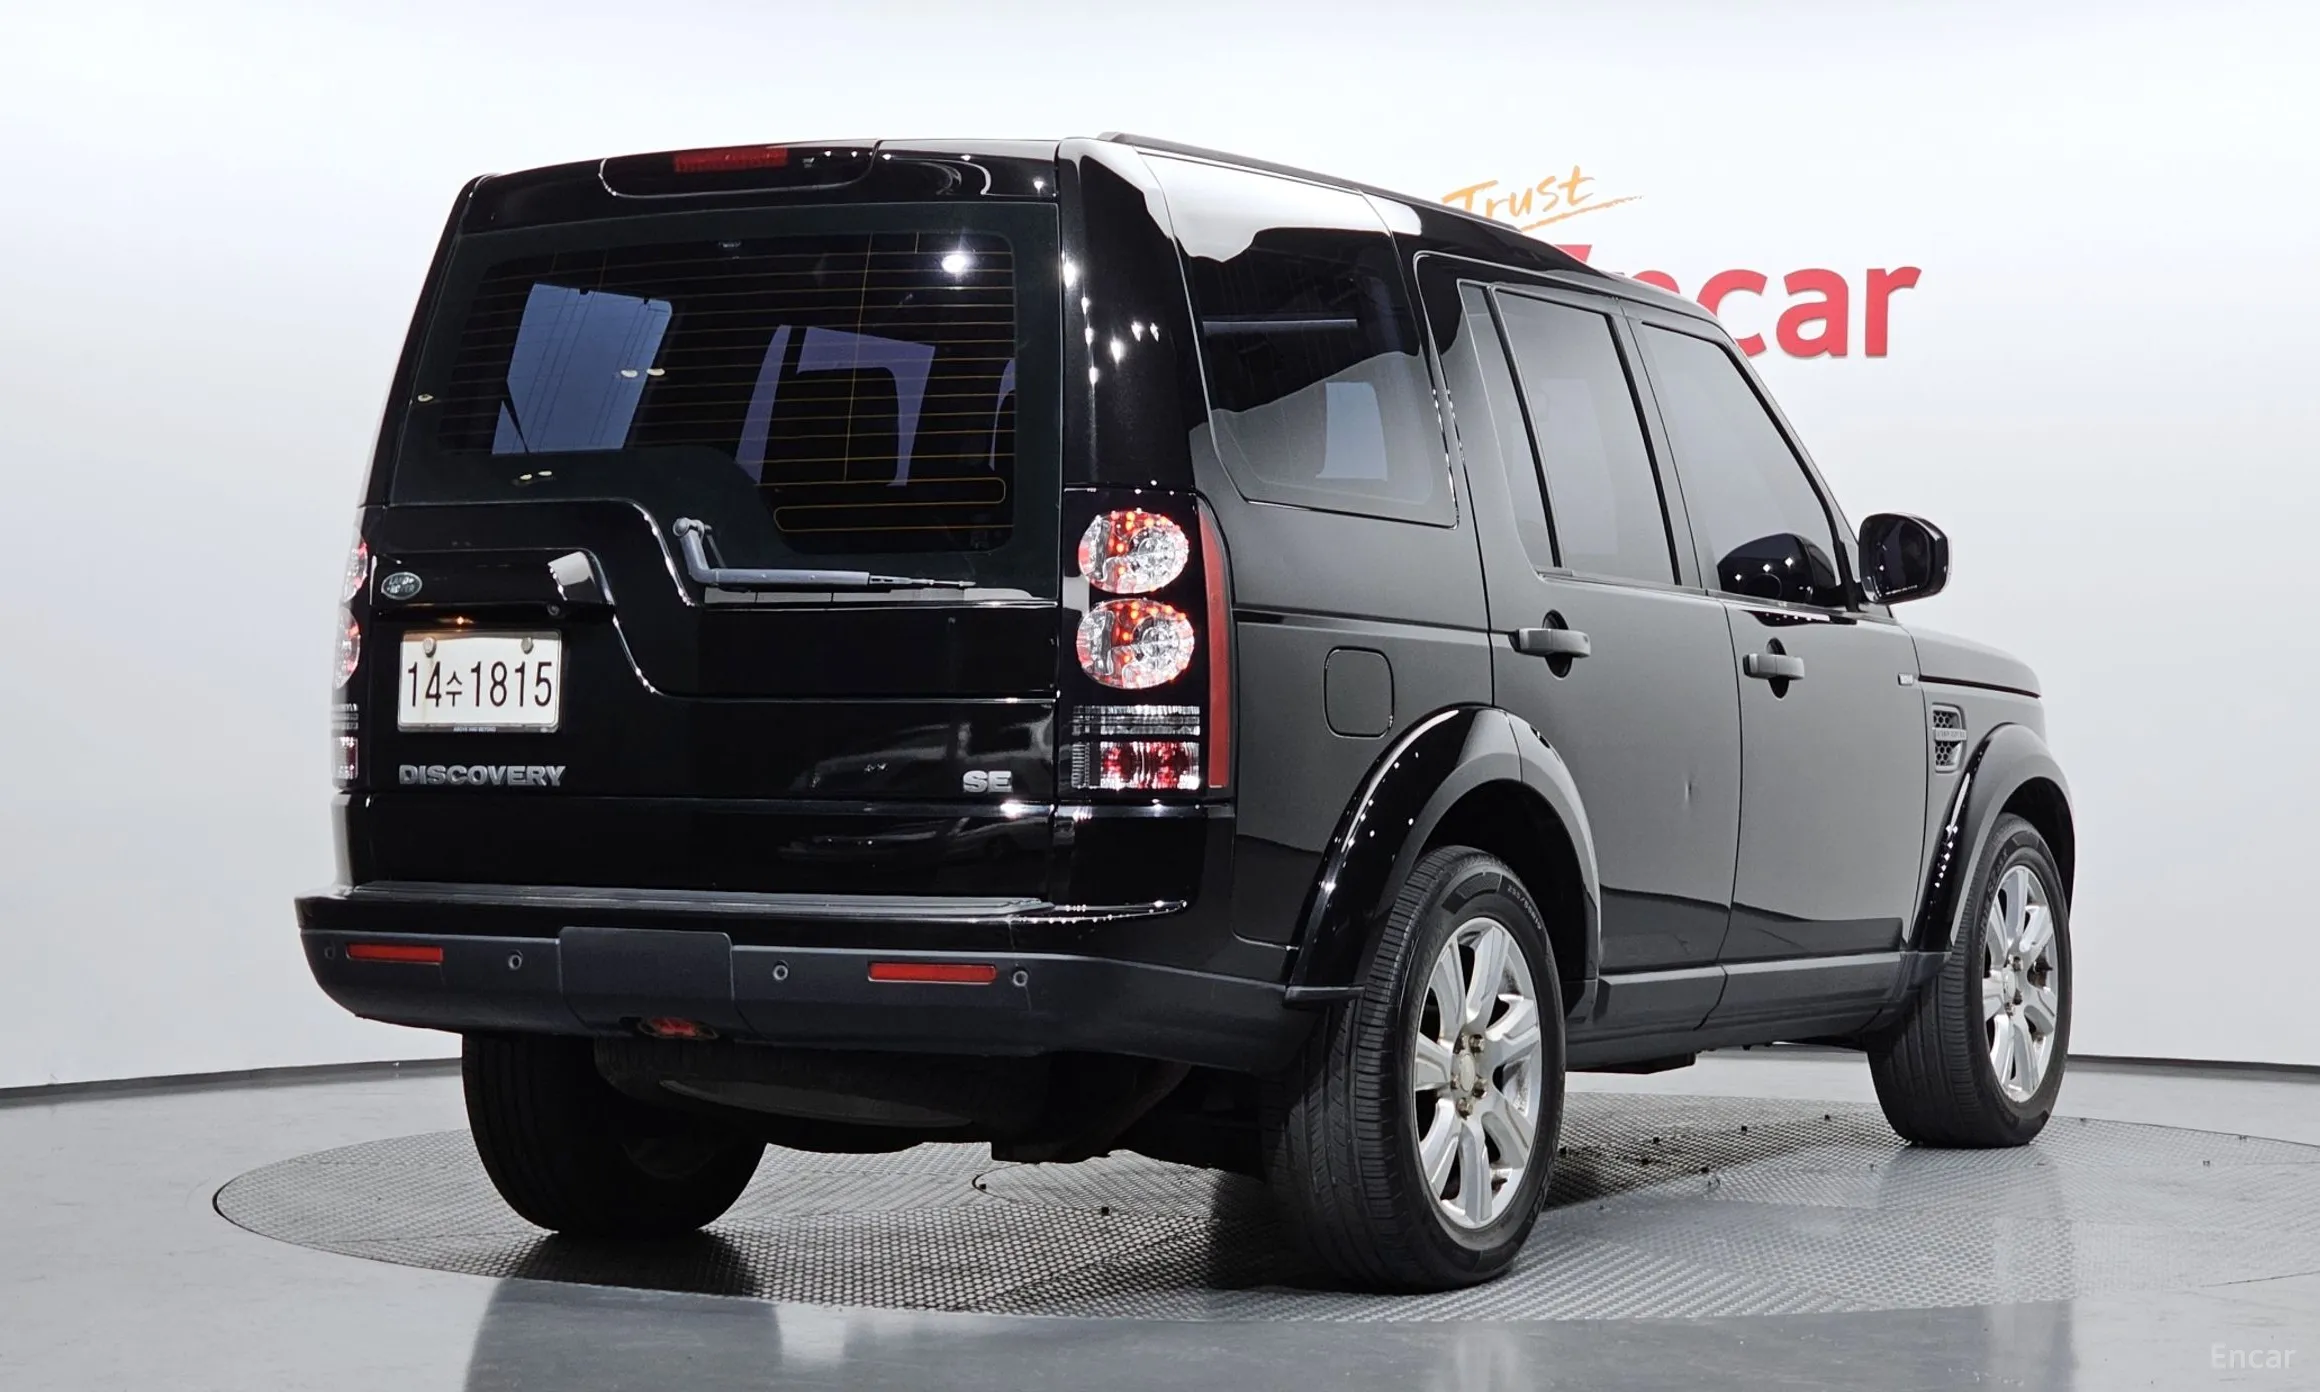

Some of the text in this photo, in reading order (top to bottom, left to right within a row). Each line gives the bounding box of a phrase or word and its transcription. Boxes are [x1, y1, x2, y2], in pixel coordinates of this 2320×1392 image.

[1442, 165, 1595, 219] Trust
[1553, 243, 1922, 358] car
[408, 661, 552, 707] 14수1815
[400, 764, 566, 786] DISCOVERY
[963, 770, 1012, 793] SE
